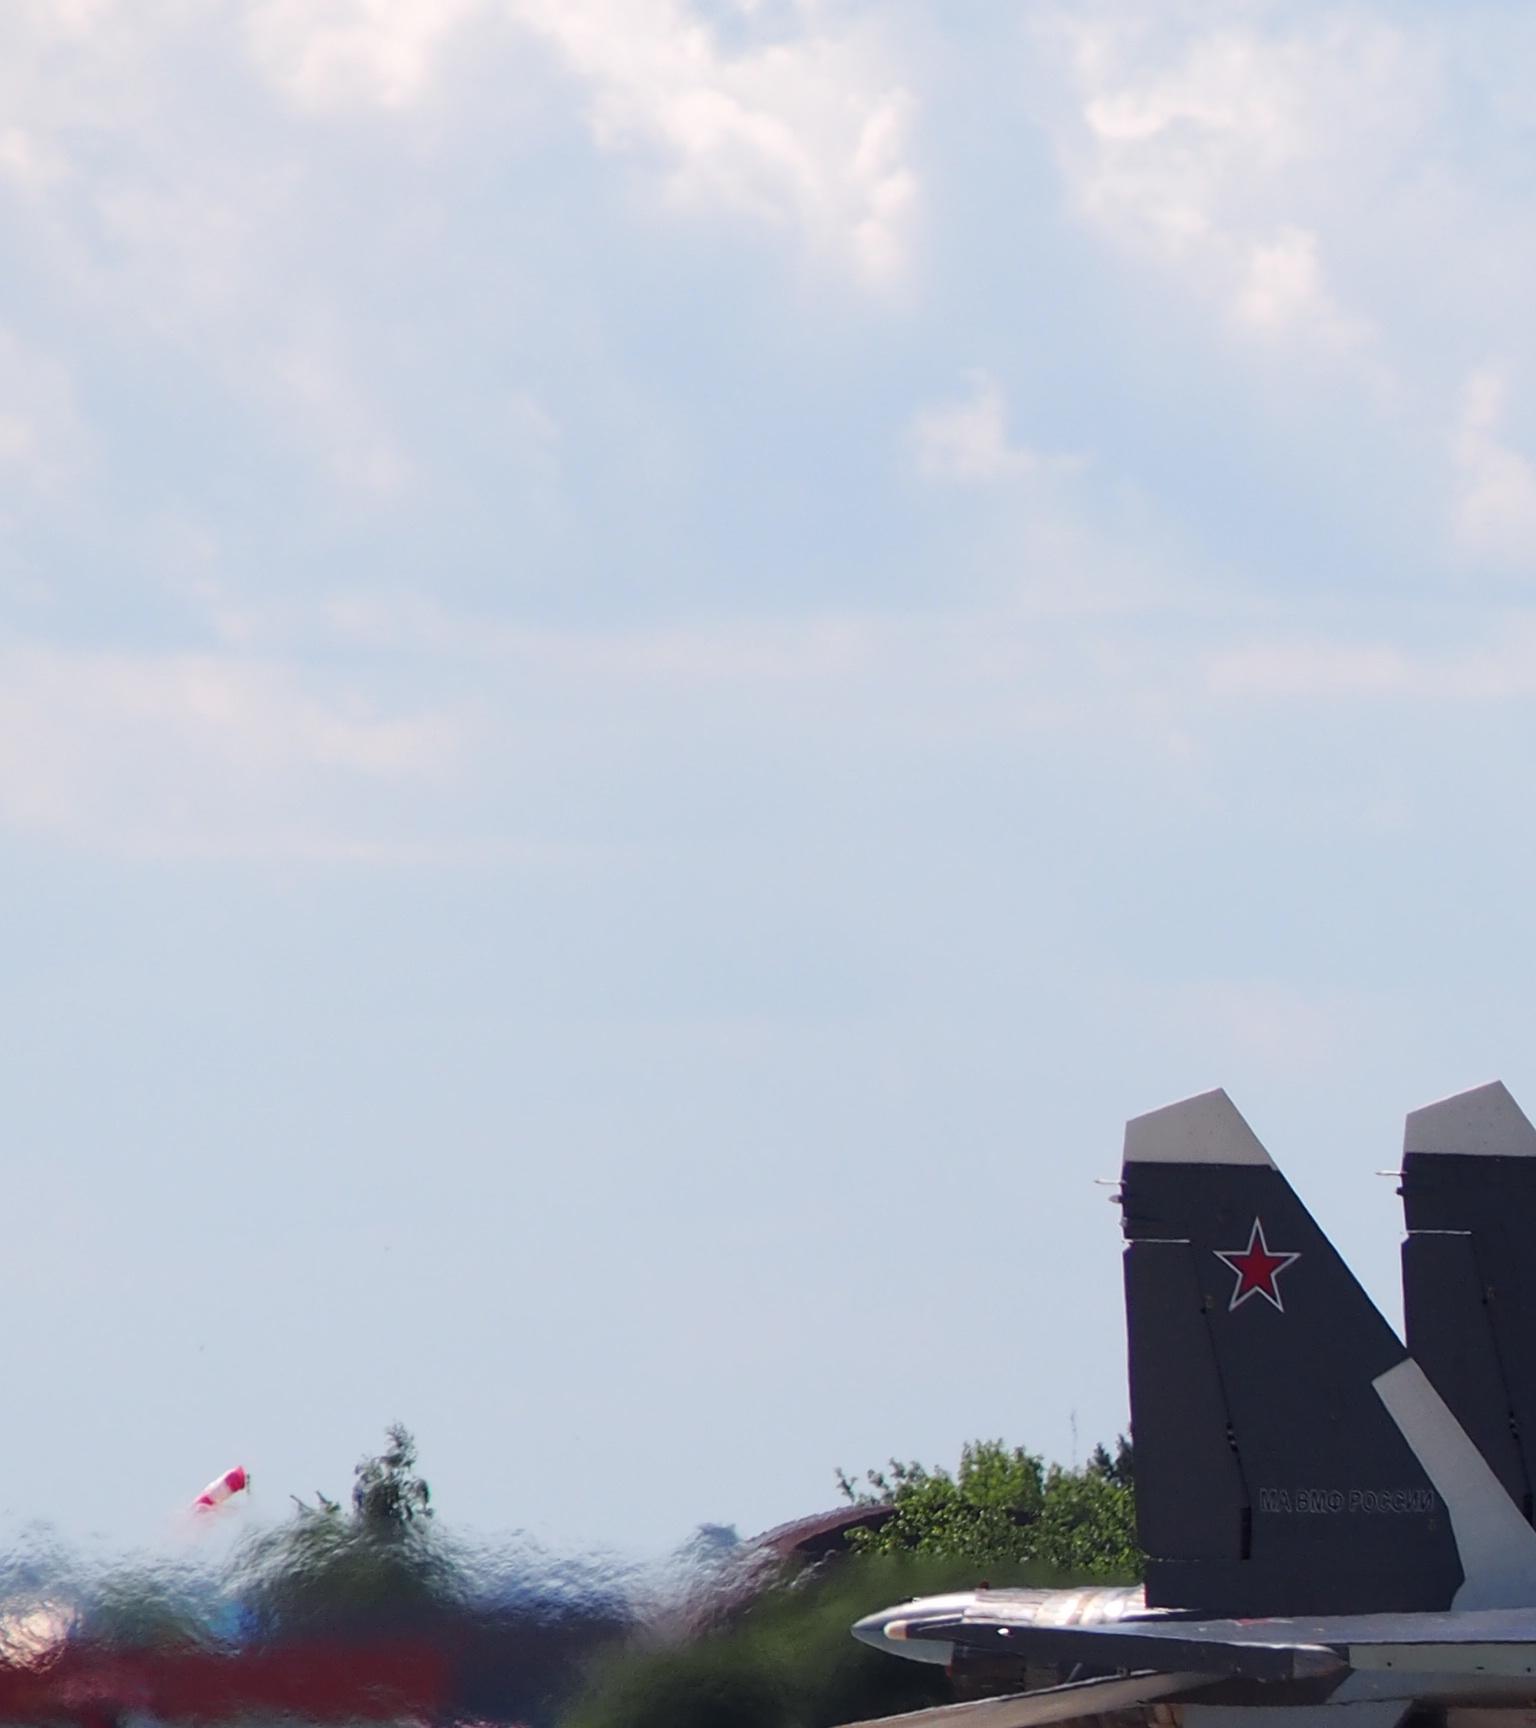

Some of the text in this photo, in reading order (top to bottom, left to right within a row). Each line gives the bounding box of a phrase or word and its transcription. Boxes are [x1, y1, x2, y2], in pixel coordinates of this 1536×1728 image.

[1259, 1488, 1435, 1513] МА ВМФ РОССИИ
